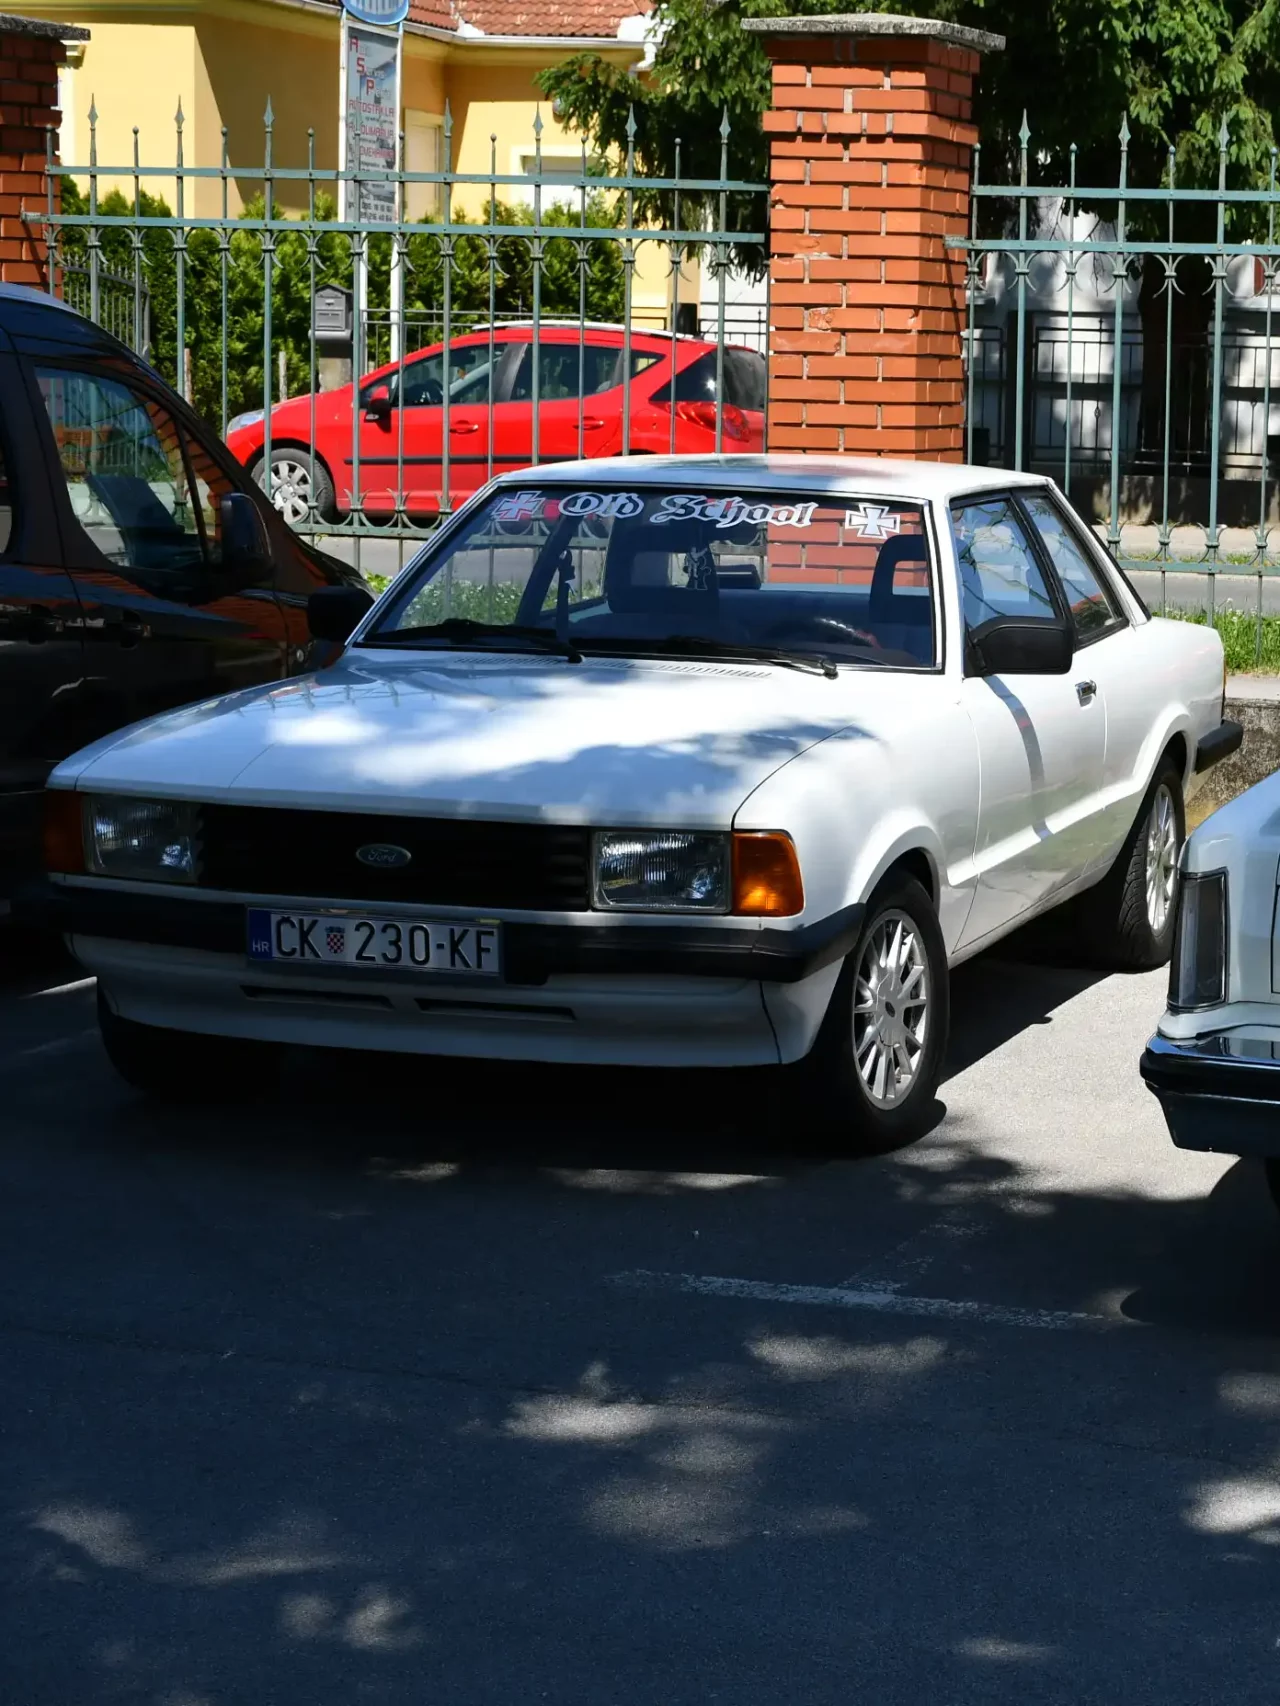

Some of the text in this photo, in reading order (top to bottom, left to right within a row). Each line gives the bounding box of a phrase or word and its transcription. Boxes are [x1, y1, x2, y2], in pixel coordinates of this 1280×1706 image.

[558, 491, 817, 528] Old School
[368, 849, 398, 862] Ford
[252, 916, 495, 969] HR ČK 230-KF
